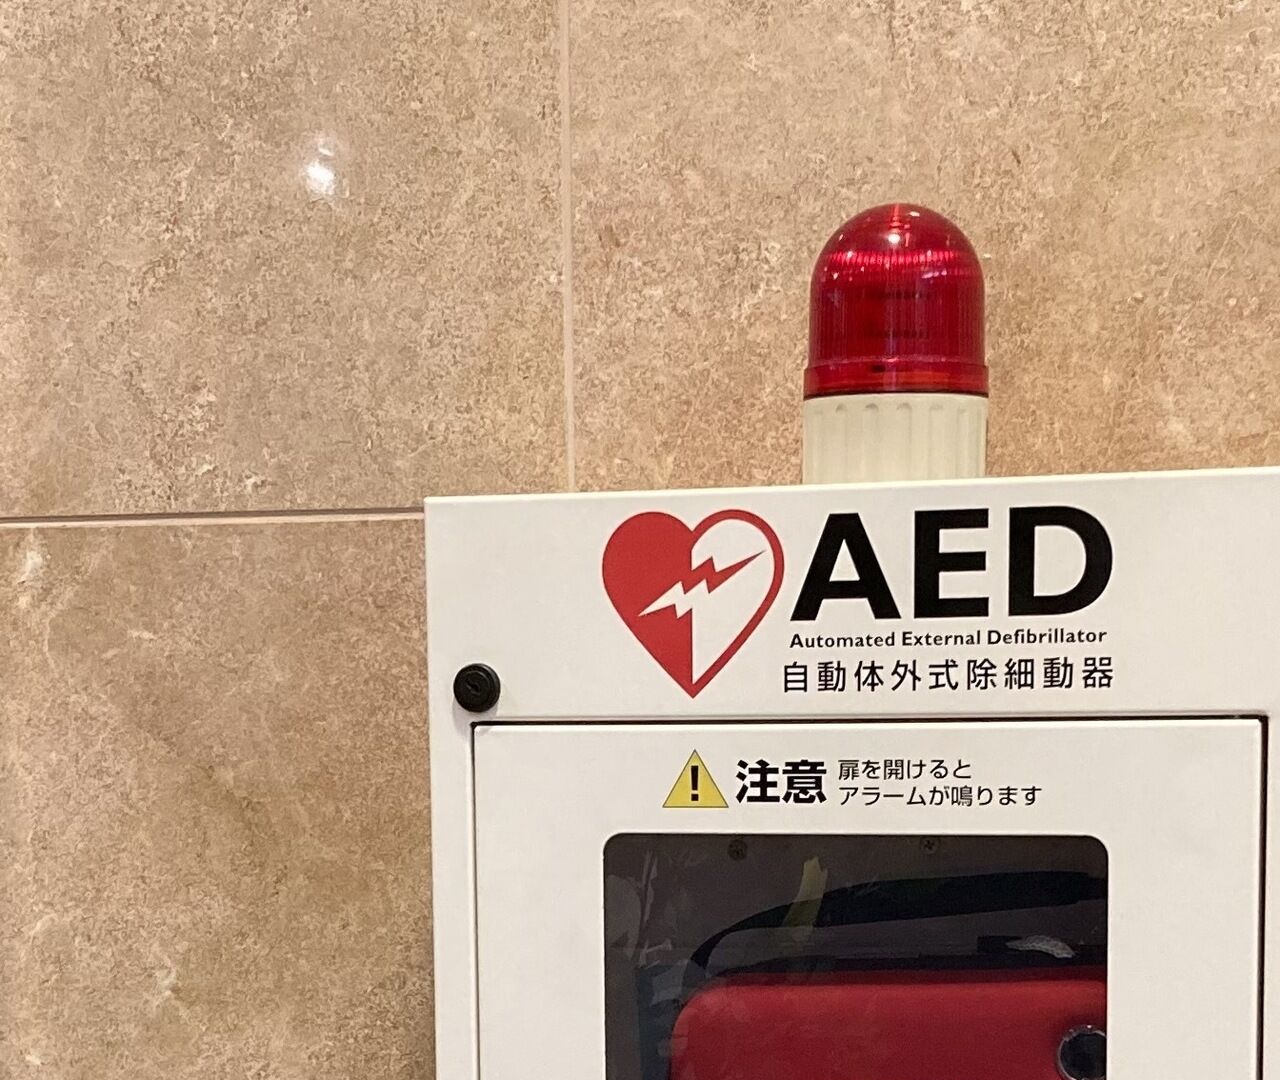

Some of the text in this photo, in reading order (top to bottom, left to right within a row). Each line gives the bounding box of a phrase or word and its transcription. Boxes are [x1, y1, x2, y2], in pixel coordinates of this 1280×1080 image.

[790, 506, 1112, 621] AED
[789, 629, 1108, 648] Automated External Defibrillator
[784, 656, 1114, 693] 自動体外式除細動器
[735, 759, 827, 804] 注意
[838, 759, 972, 780] 扉を開けると
[838, 785, 1043, 806] アラームが鳴ります
